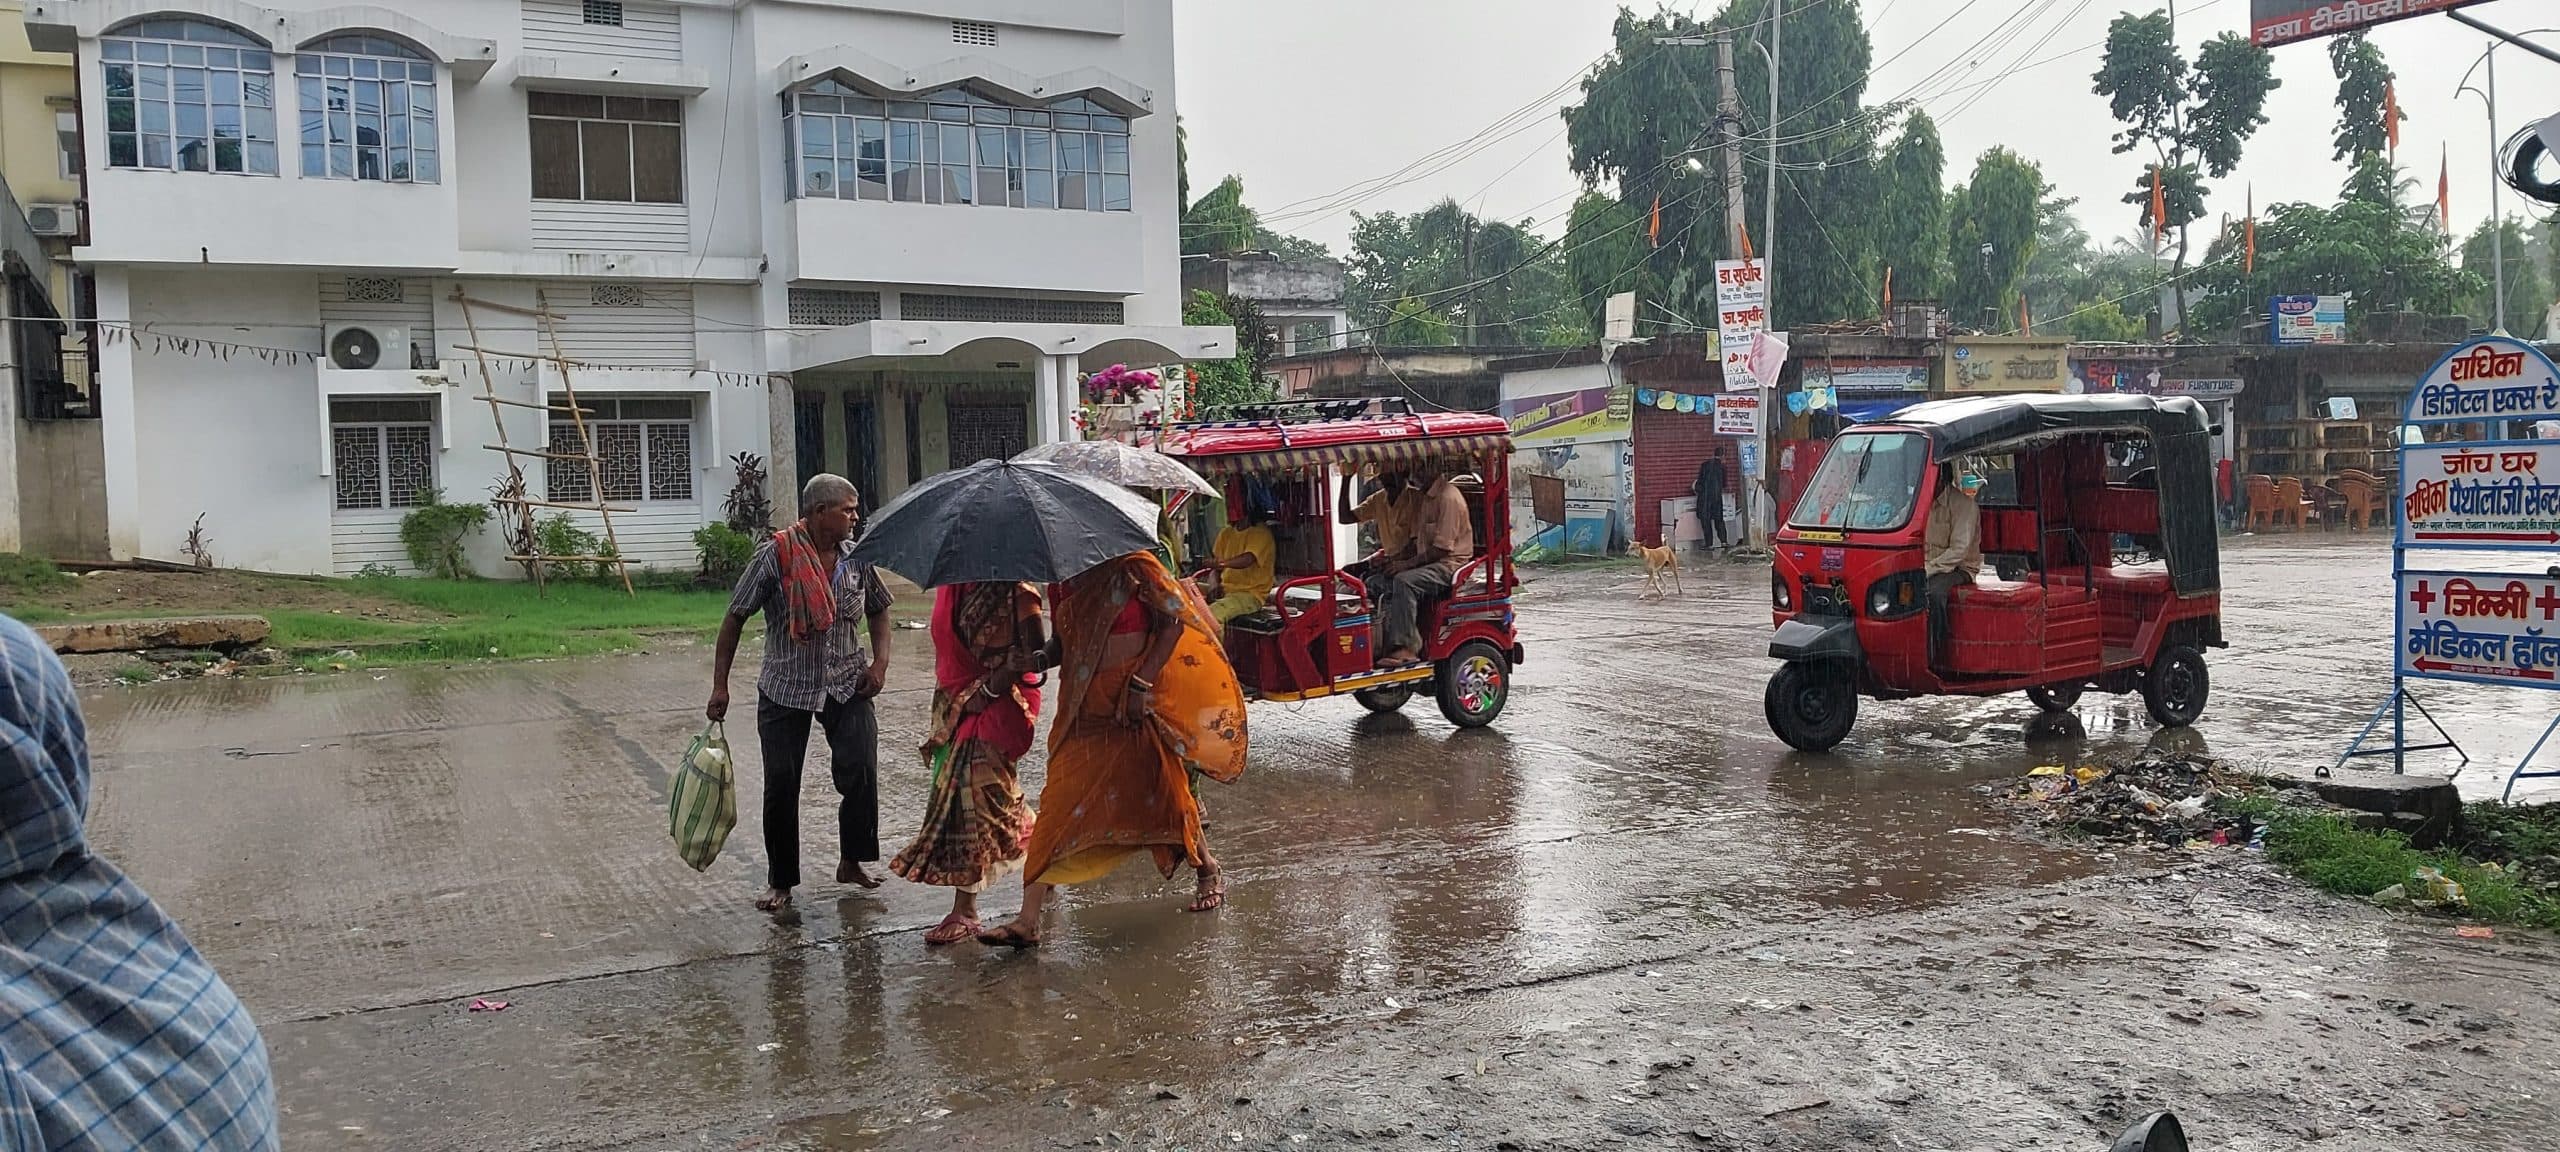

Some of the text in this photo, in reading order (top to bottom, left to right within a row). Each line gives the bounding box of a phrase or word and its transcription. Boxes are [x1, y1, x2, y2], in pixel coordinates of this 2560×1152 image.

[2257, 20, 2305, 42] उषा
[2310, 0, 2402, 33] टीवीएस
[1733, 262, 1762, 287] सुधीर
[2451, 345, 2525, 381] राधिका
[2188, 380, 2234, 391] FURNITURE
[2422, 384, 2490, 416] डिजिटल
[2500, 451, 2538, 476] घर
[2405, 478, 2448, 522] राधिका
[2450, 476, 2525, 516] पैथोलॉजी
[2443, 578, 2530, 618] जिम्मी
[2408, 619, 2510, 662] मेडिकल
